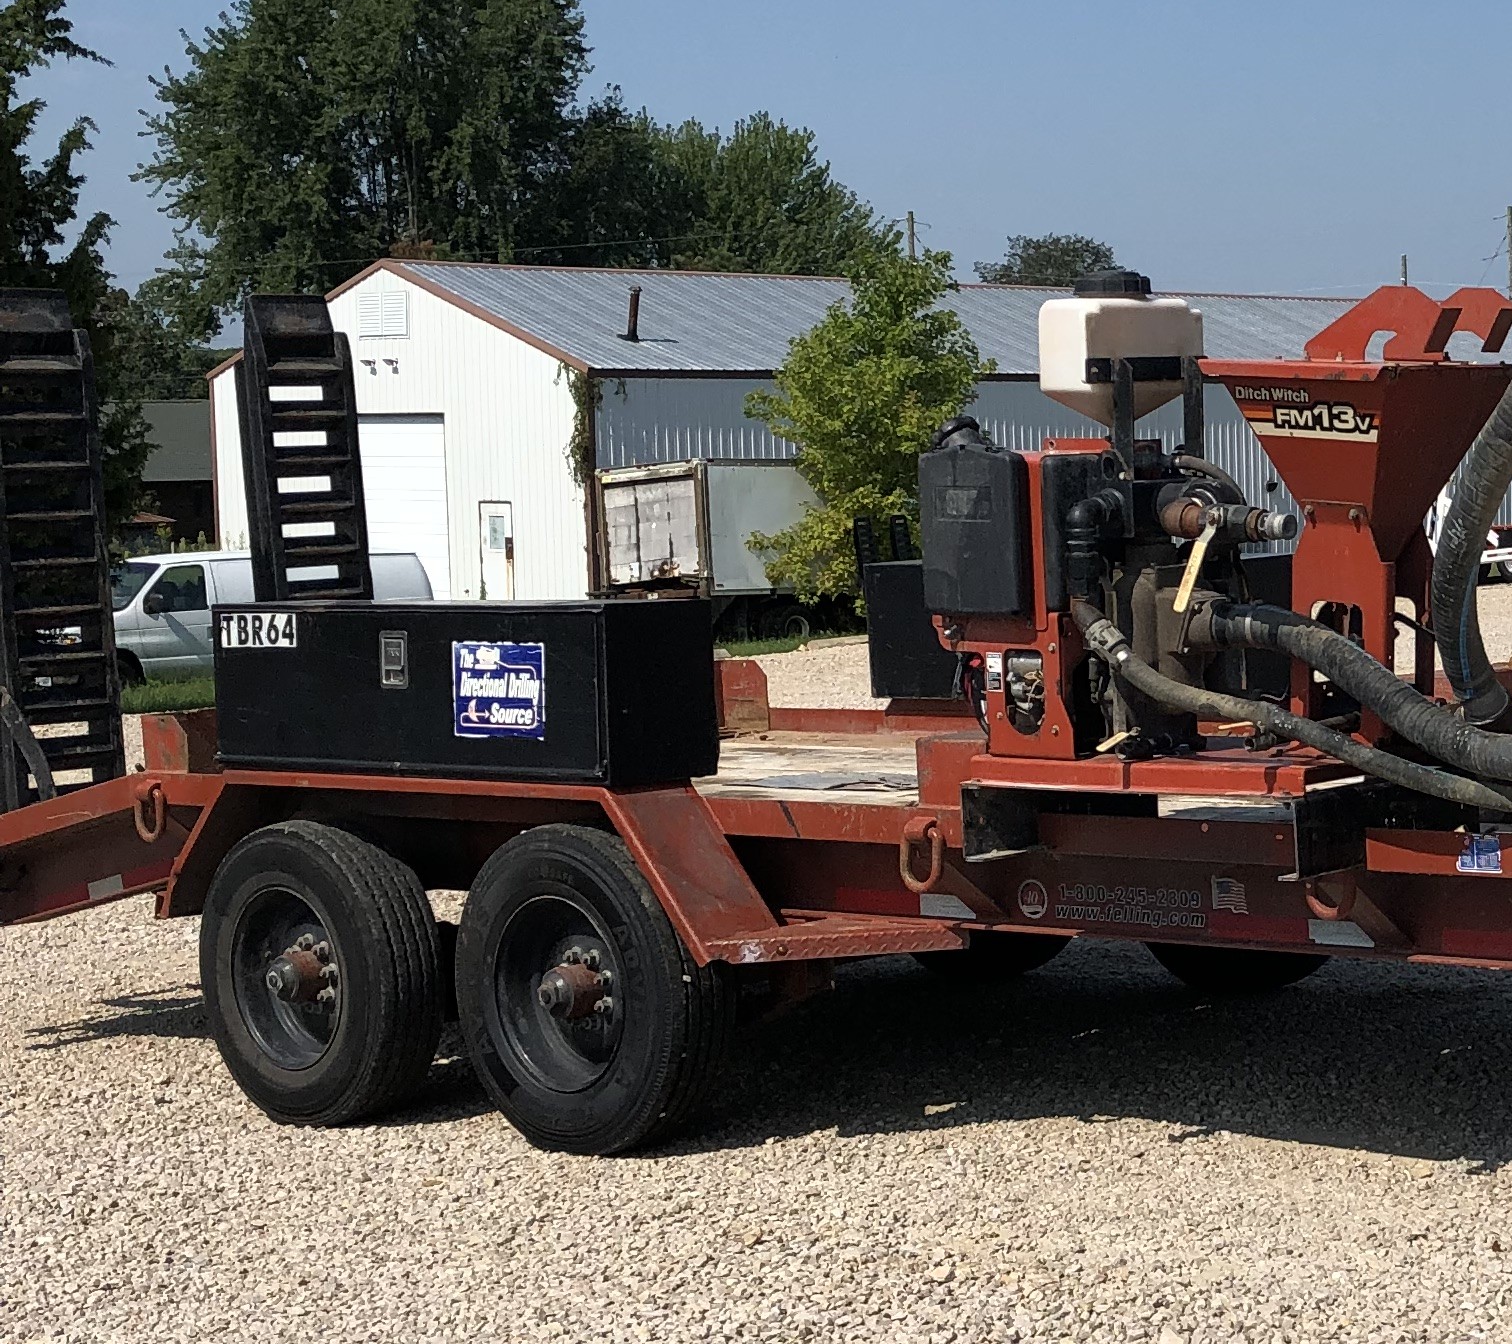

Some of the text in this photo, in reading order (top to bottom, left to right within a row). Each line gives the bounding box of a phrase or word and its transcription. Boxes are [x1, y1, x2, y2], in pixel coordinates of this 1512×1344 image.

[1234, 386, 1309, 403] Ditch Witch
[222, 614, 295, 646] TBR64
[460, 648, 475, 669] The
[460, 671, 540, 706] Directional Drilling
[489, 702, 533, 724] Source
[1057, 883, 1201, 909] 1-800-245-2809
[1055, 904, 1206, 928] www.felling.com
